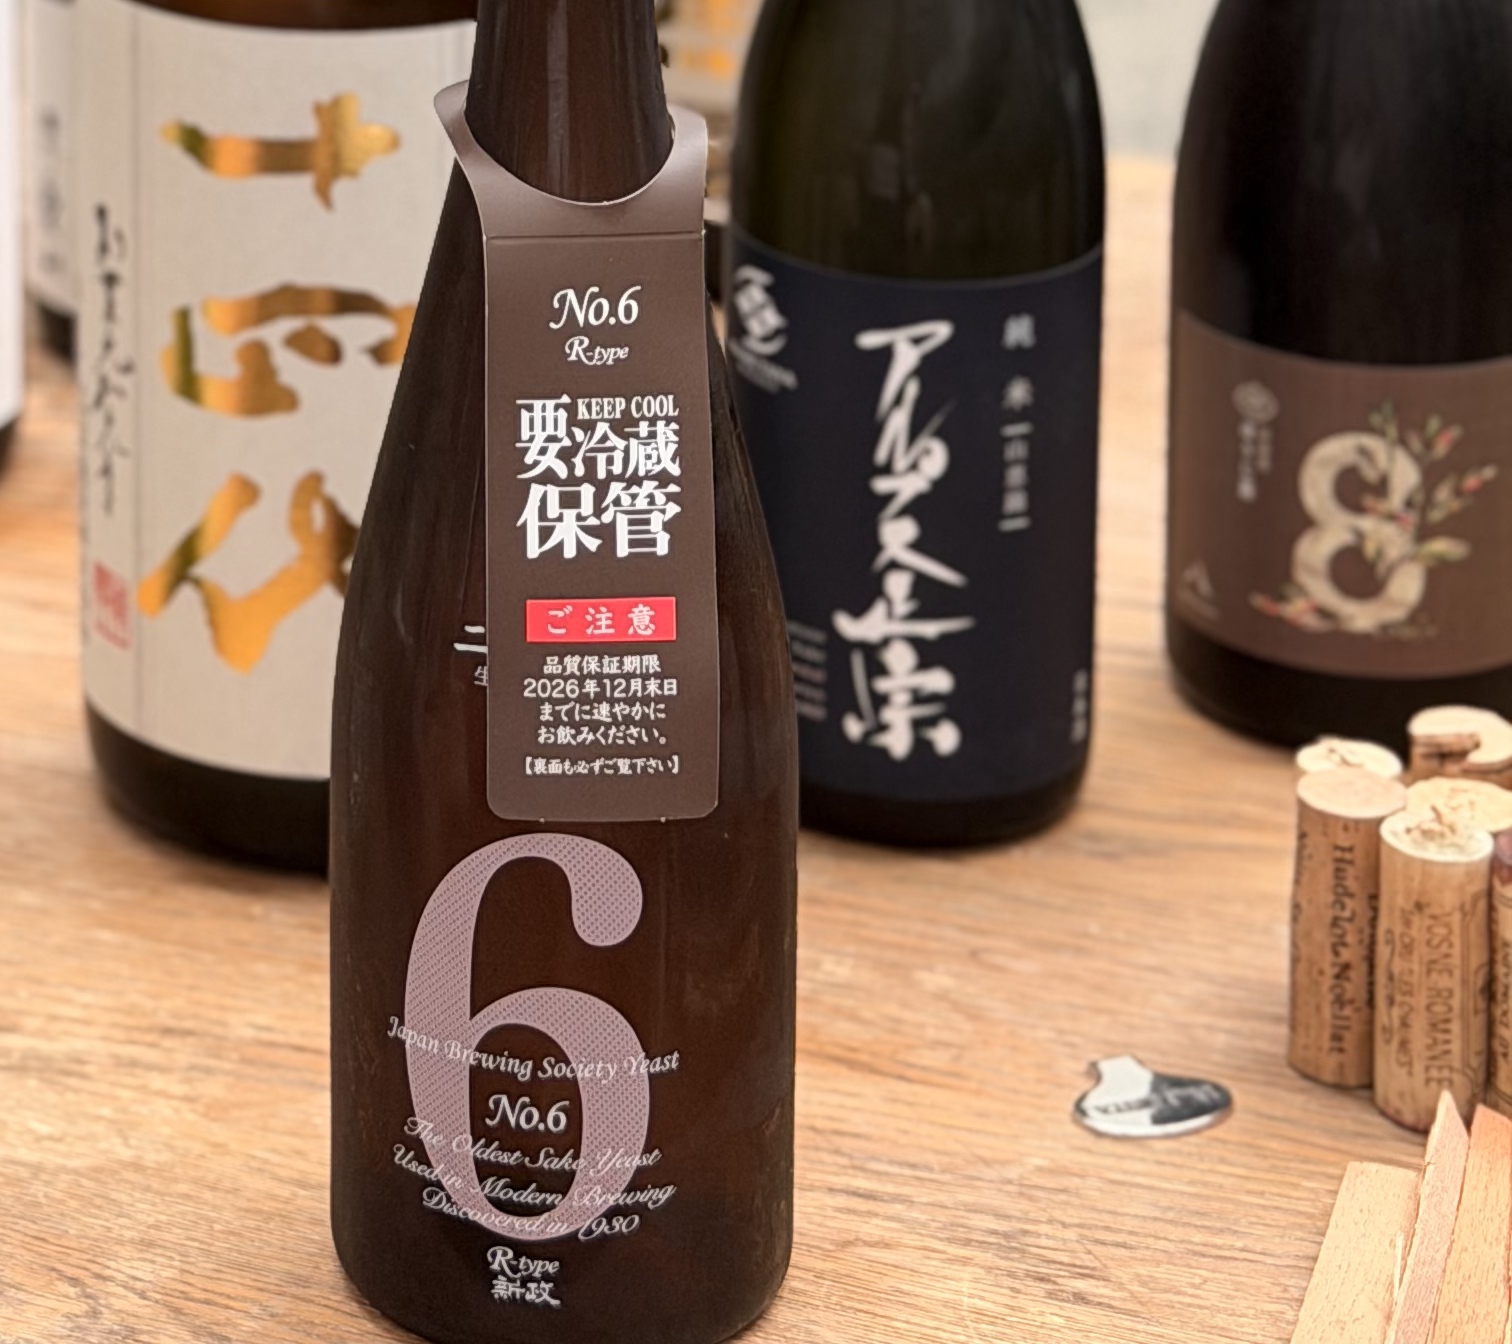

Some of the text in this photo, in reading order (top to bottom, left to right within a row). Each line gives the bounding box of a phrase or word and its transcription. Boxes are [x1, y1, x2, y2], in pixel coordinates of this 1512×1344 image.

[548, 285, 642, 330] No.6
[564, 335, 630, 366] R-type
[576, 394, 680, 420] KEEP COOL
[515, 393, 682, 480] 要冷蔵
[515, 480, 683, 559] 保管
[546, 603, 656, 636] ご注意
[543, 654, 662, 676] 品質保証期限
[522, 677, 679, 700] 2026年12月末日
[538, 701, 668, 722] までに速やかに
[536, 724, 669, 745] お飲みください。
[388, 1015, 681, 1085] Japan Brewing Society Yeast
[403, 831, 651, 1242] 6
[484, 1093, 570, 1133] No.6
[403, 1115, 662, 1177] The Oldest Sake Yeast
[392, 1143, 678, 1211] Used in Modern Brewing
[421, 1185, 640, 1242] Discovered in 1930
[486, 1245, 561, 1279] R-type
[490, 1276, 562, 1306] 新政
